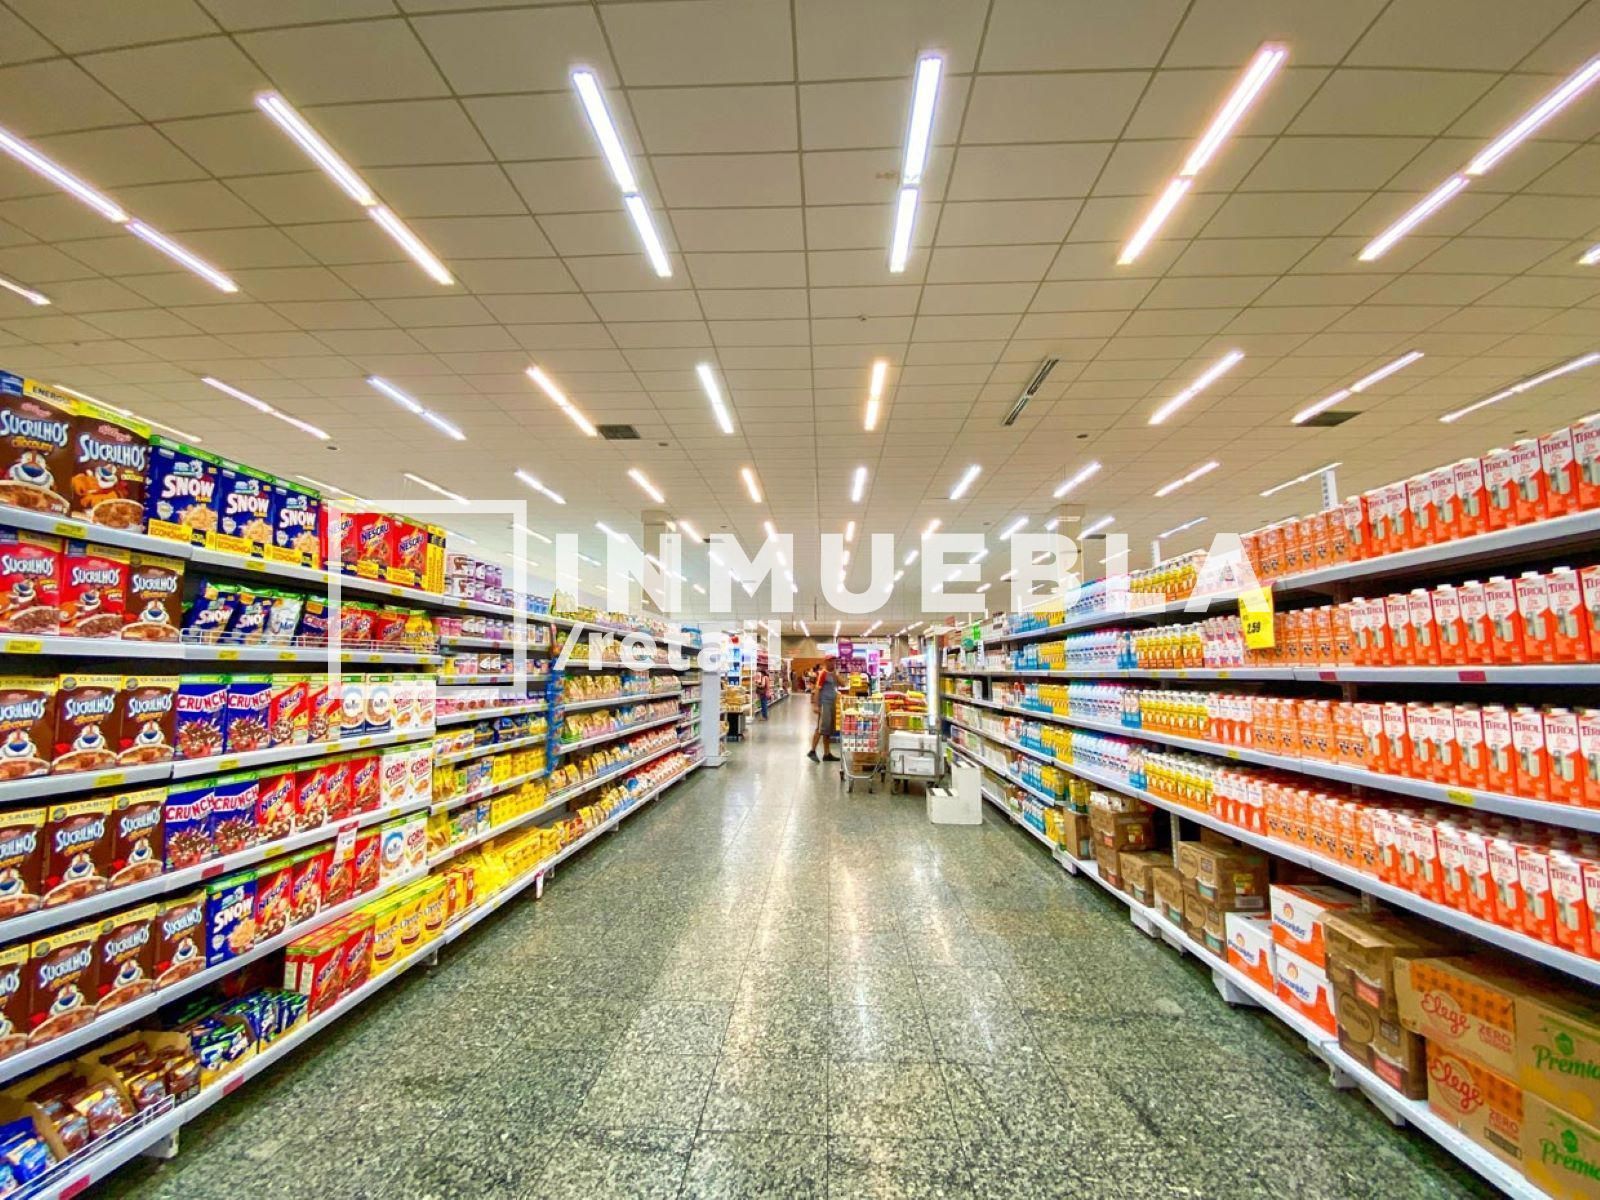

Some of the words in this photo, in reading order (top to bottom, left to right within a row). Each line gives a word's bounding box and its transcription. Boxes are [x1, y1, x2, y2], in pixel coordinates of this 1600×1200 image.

[0, 410, 69, 446] SUCRILHOS
[79, 434, 147, 472] SUCRILHOS
[1542, 440, 1571, 455] TIROL
[1512, 451, 1537, 465] TIROL
[162, 474, 215, 498] SNOW
[226, 493, 270, 514] SNOW
[279, 508, 317, 528] SNOW
[361, 521, 389, 543] NESCAU
[398, 533, 424, 551] NESCAU
[2, 555, 55, 575] SUCRILHOS
[72, 567, 120, 586] SUCRILHOS
[132, 574, 178, 593] SUCRILHOS
[1486, 591, 1512, 601] TIROL
[1518, 587, 1546, 597] TIROL
[1550, 583, 1577, 593] TIROL
[65, 694, 116, 720] SUCRILHOS
[129, 693, 173, 717] SUCRILHOS
[178, 690, 227, 710] CRUNCH
[229, 689, 271, 709] CRUNCH
[1485, 720, 1509, 731] TIROL
[1513, 722, 1540, 733] TIROL
[1546, 724, 1576, 735] TIROL
[214, 787, 258, 808] CRUNCH
[166, 796, 214, 820] CRUNCH
[121, 806, 161, 838] SUCRILHOS
[56, 818, 105, 852] SUCRILHOS
[1519, 860, 1544, 874] TIROL
[1551, 869, 1579, 884] TIROL
[163, 905, 202, 940] SUCRILHOS
[213, 896, 254, 934] SNOW
[105, 923, 150, 962] SUCRILHOS
[40, 945, 92, 989] SUCRILHOS
[1478, 1023, 1511, 1046] ZERO
